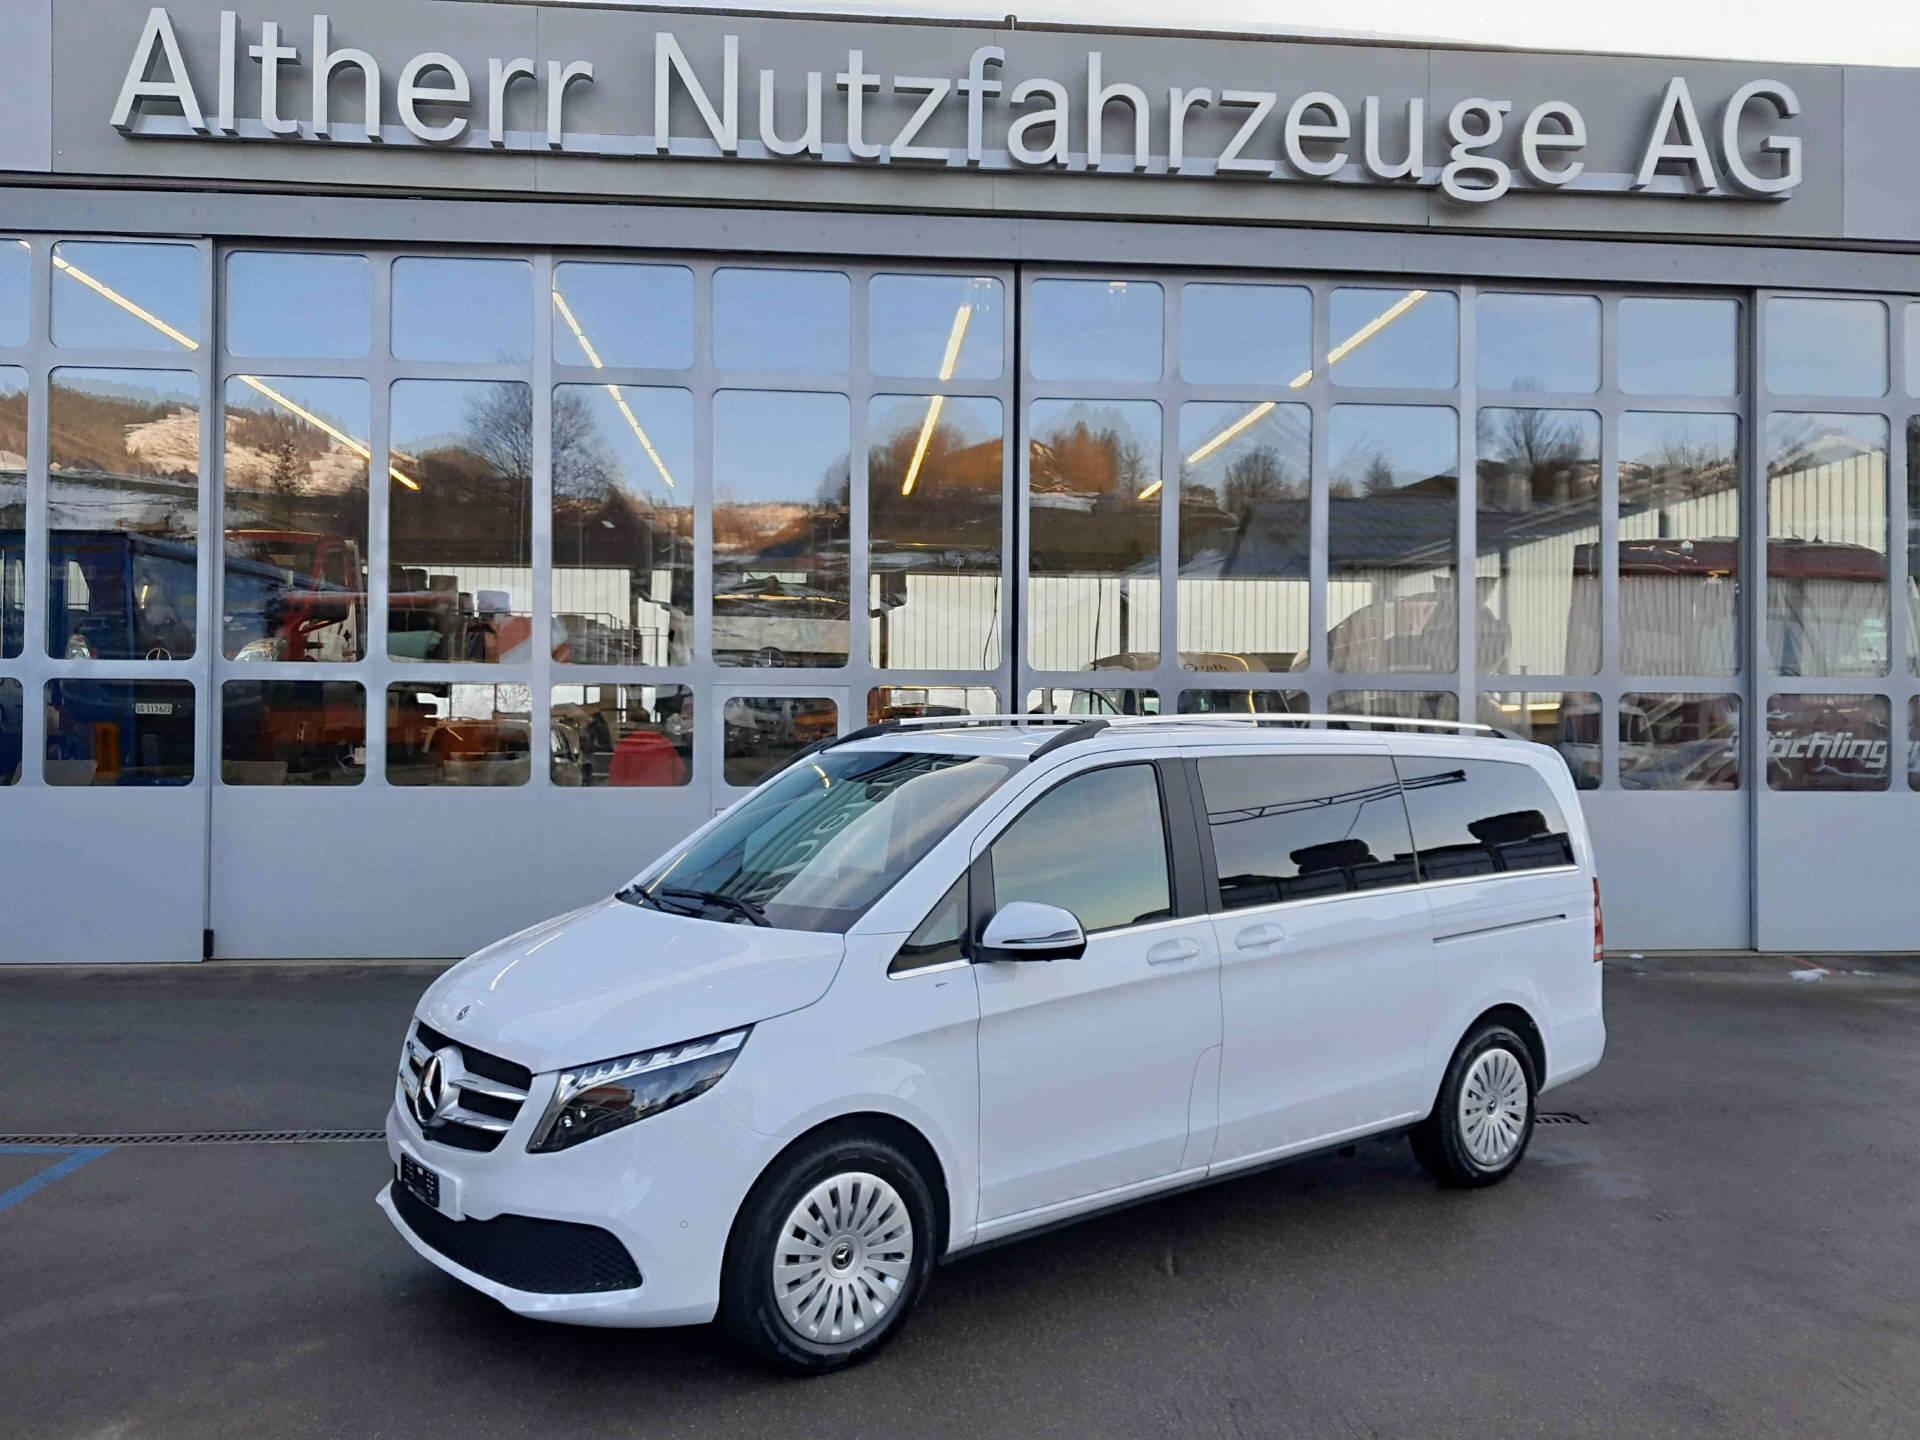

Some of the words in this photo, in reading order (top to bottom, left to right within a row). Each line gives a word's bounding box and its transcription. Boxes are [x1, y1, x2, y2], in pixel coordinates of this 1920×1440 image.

[110, 7, 594, 152] Altherr
[653, 31, 1588, 204] Nutzfahrzeuge
[1630, 76, 1802, 199] AG
